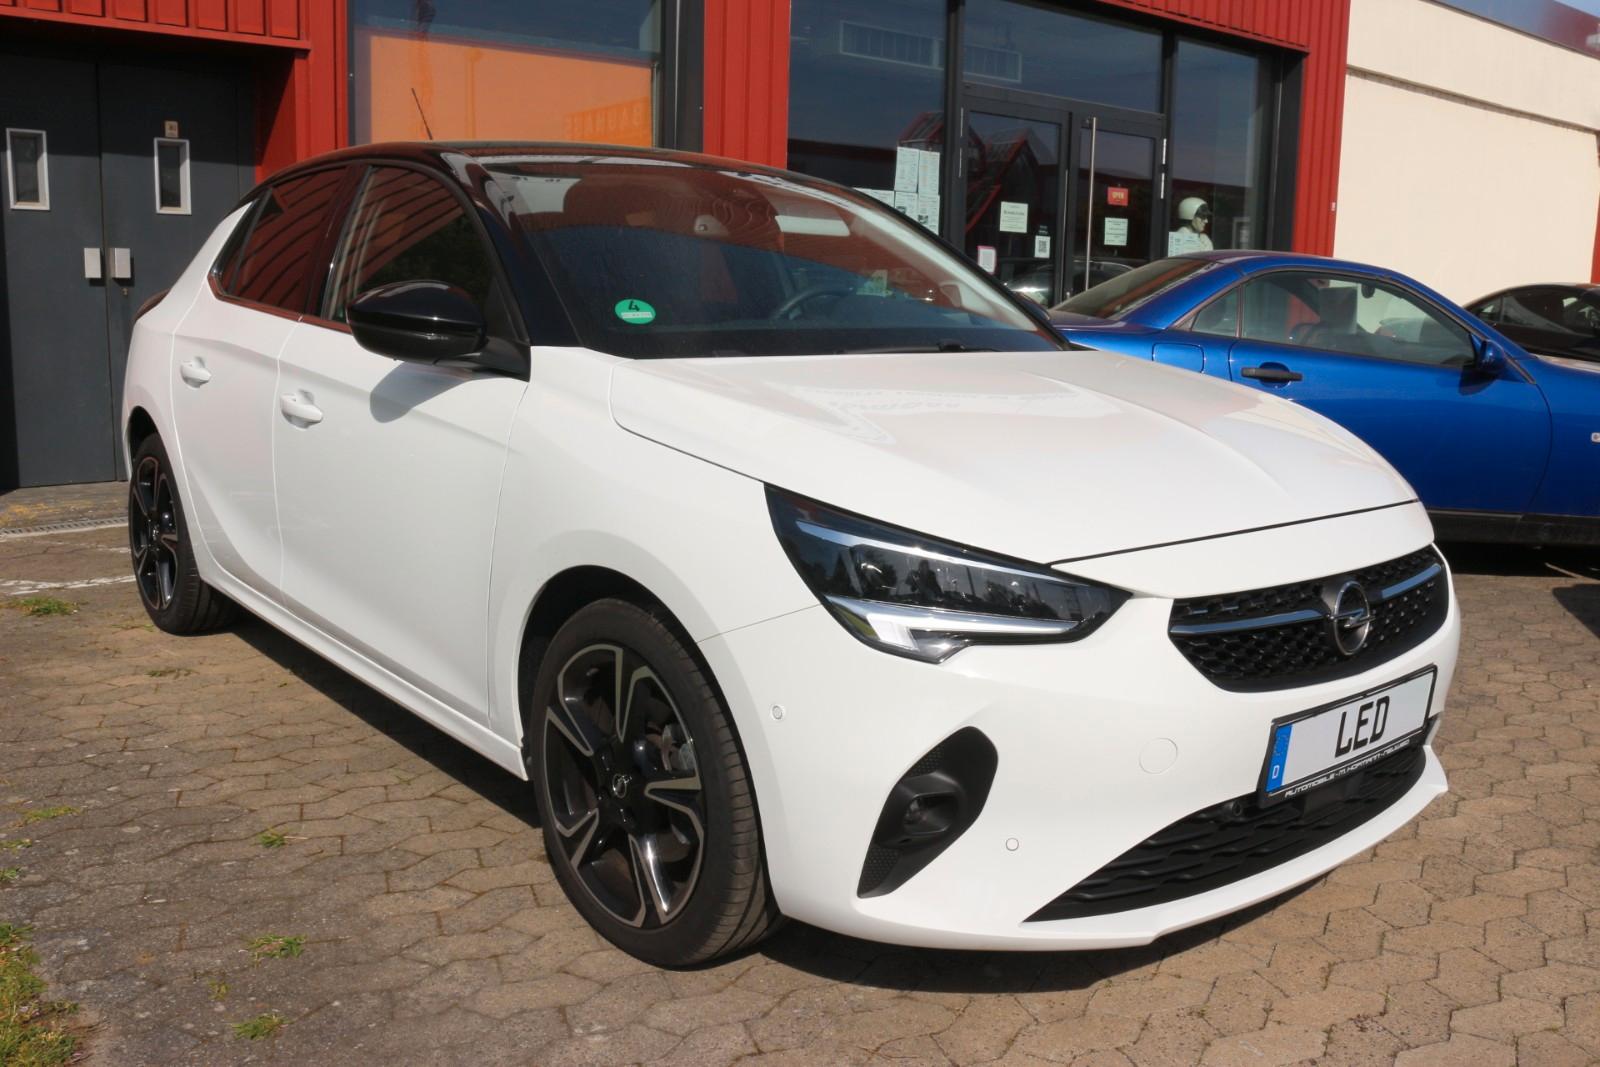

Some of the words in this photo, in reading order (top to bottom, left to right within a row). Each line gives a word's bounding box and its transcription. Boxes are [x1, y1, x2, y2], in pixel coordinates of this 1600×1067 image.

[628, 299, 640, 311] 4
[1335, 695, 1391, 759] LED
[1272, 764, 1280, 779] D
